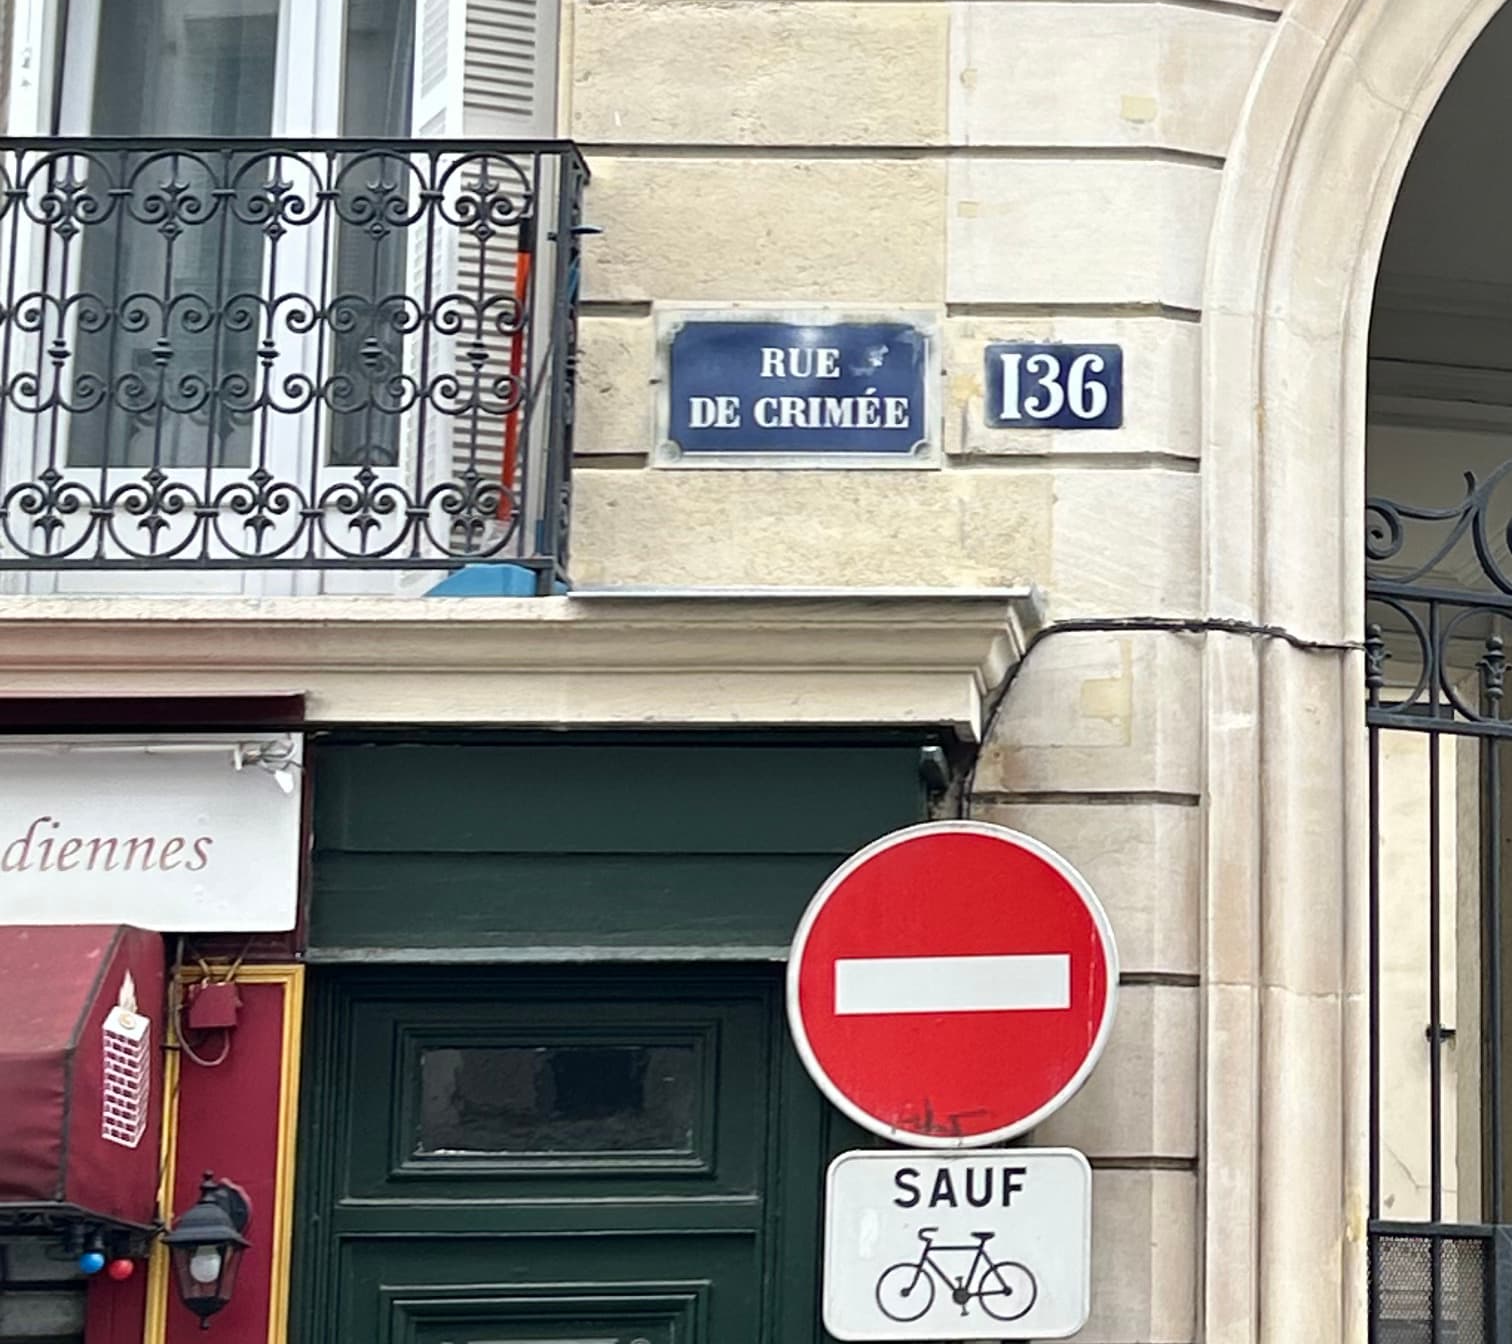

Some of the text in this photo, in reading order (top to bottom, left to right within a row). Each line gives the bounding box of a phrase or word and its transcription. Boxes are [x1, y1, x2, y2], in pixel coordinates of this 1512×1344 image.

[759, 347, 841, 379] RUE
[688, 386, 911, 429] DE CRIMÉE
[999, 352, 1109, 421] 136
[893, 1166, 1028, 1209] SAUF
